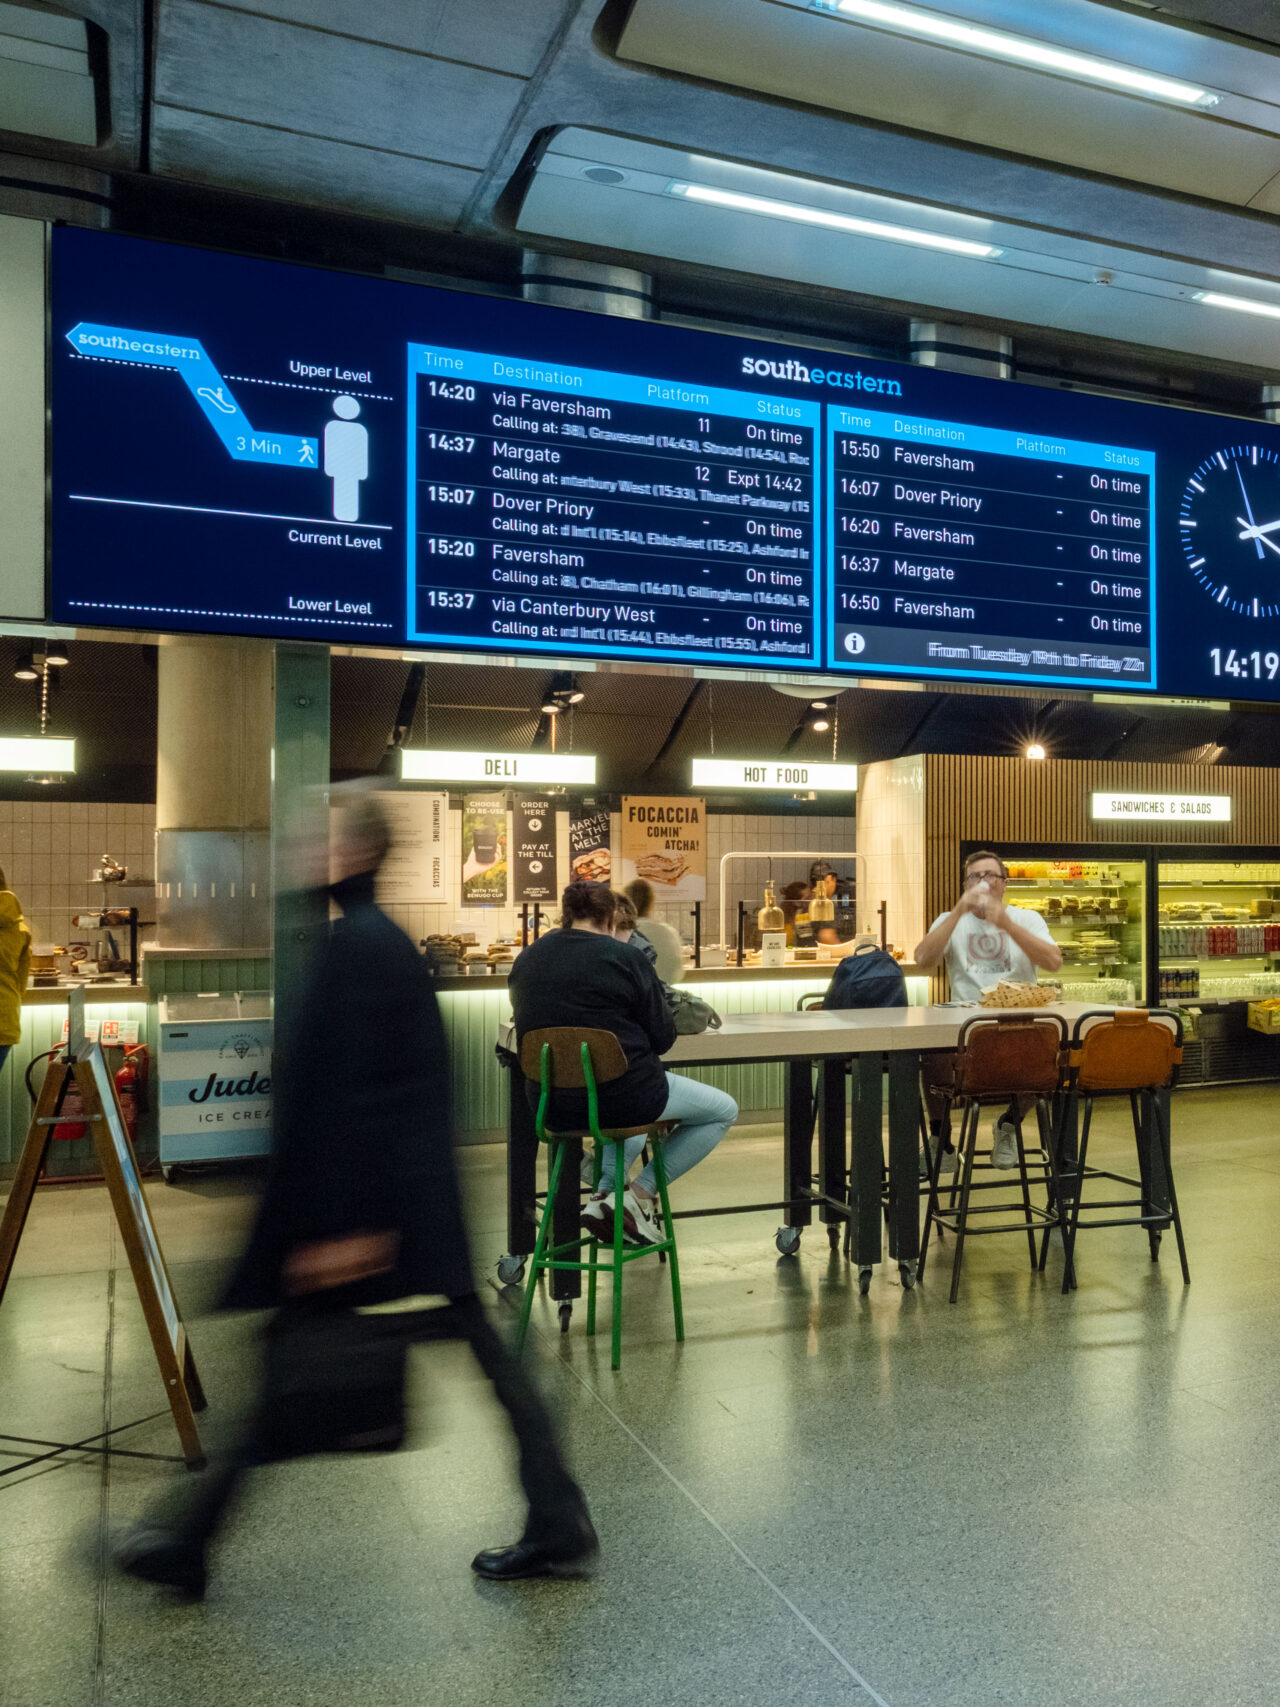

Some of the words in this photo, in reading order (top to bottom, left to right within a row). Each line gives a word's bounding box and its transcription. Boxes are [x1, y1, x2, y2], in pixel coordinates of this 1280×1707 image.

[78, 332, 201, 361] southeastern
[289, 360, 331, 381] Upper
[335, 365, 372, 384] Level
[741, 356, 903, 396] southeastern
[424, 352, 464, 370] Time
[494, 362, 583, 387] Destination
[648, 385, 709, 405] Platform
[757, 400, 801, 418] Status
[429, 381, 475, 401] 14:20
[492, 393, 516, 407] via
[521, 394, 611, 420] Faversham
[698, 418, 710, 433] 11
[746, 425, 765, 440] On
[770, 427, 803, 444] time
[236, 436, 246, 451] 3
[251, 438, 281, 456] Min
[429, 433, 475, 453] 14:37
[493, 442, 561, 464] Margate
[695, 466, 710, 481] 12
[728, 471, 760, 488] Expt
[765, 475, 802, 492] 14:42
[841, 439, 880, 459] 15:50
[894, 447, 974, 472] Faversham
[1090, 474, 1110, 490] On
[1112, 477, 1141, 494] time
[429, 486, 475, 505] 15:07
[493, 493, 541, 513] Dover
[546, 497, 594, 519] Priory
[746, 520, 765, 535] On
[770, 522, 803, 539] time
[288, 530, 342, 546] Current
[345, 533, 382, 550] Level
[428, 539, 475, 557] 15:20
[493, 545, 585, 567] Faversham
[746, 568, 765, 583] On
[770, 570, 803, 586] time
[288, 597, 331, 614] Lower
[335, 599, 372, 615] Level
[428, 591, 475, 609] 15:37
[492, 598, 515, 613] via
[520, 598, 611, 623] Canterbury
[614, 605, 655, 623] West
[746, 616, 765, 631] On
[770, 618, 803, 634] time
[1210, 647, 1278, 680] 14:19
[484, 759, 517, 776] DELI
[744, 767, 767, 782] HOT
[777, 768, 808, 783] FOOD
[629, 806, 699, 823] FOCACCIA
[1112, 801, 1164, 813] SANDWICHES
[1181, 803, 1211, 814] SALADS
[569, 813, 610, 833] MARVEL
[571, 832, 584, 843] AT
[586, 822, 609, 837] THE
[574, 835, 602, 851] MELT
[665, 839, 699, 851] ATCHA!
[518, 850, 534, 858] THE
[189, 1071, 270, 1103] Jude
[199, 1113, 224, 1122] ICE
[233, 1111, 271, 1120] CREA
